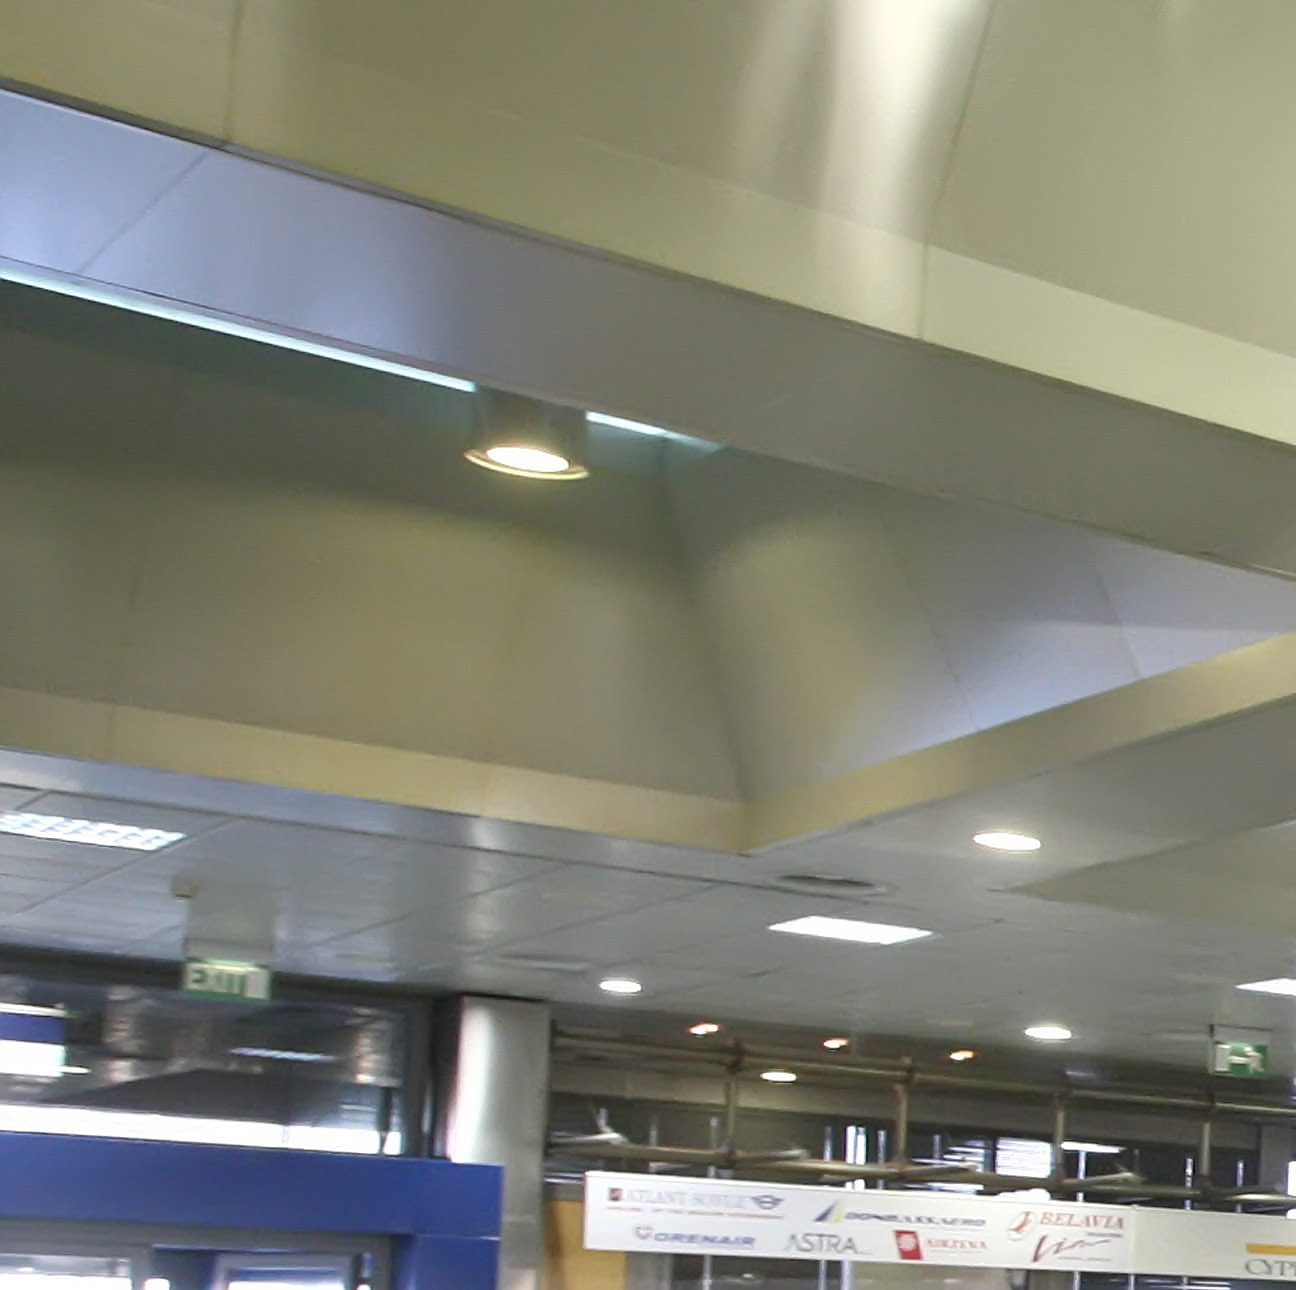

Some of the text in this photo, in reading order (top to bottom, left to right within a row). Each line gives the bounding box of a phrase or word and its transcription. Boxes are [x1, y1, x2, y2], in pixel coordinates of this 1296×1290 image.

[1040, 1211, 1125, 1230] BELAVIA
[654, 1232, 756, 1248] ORENAIR
[785, 1233, 859, 1255] ASTRA
